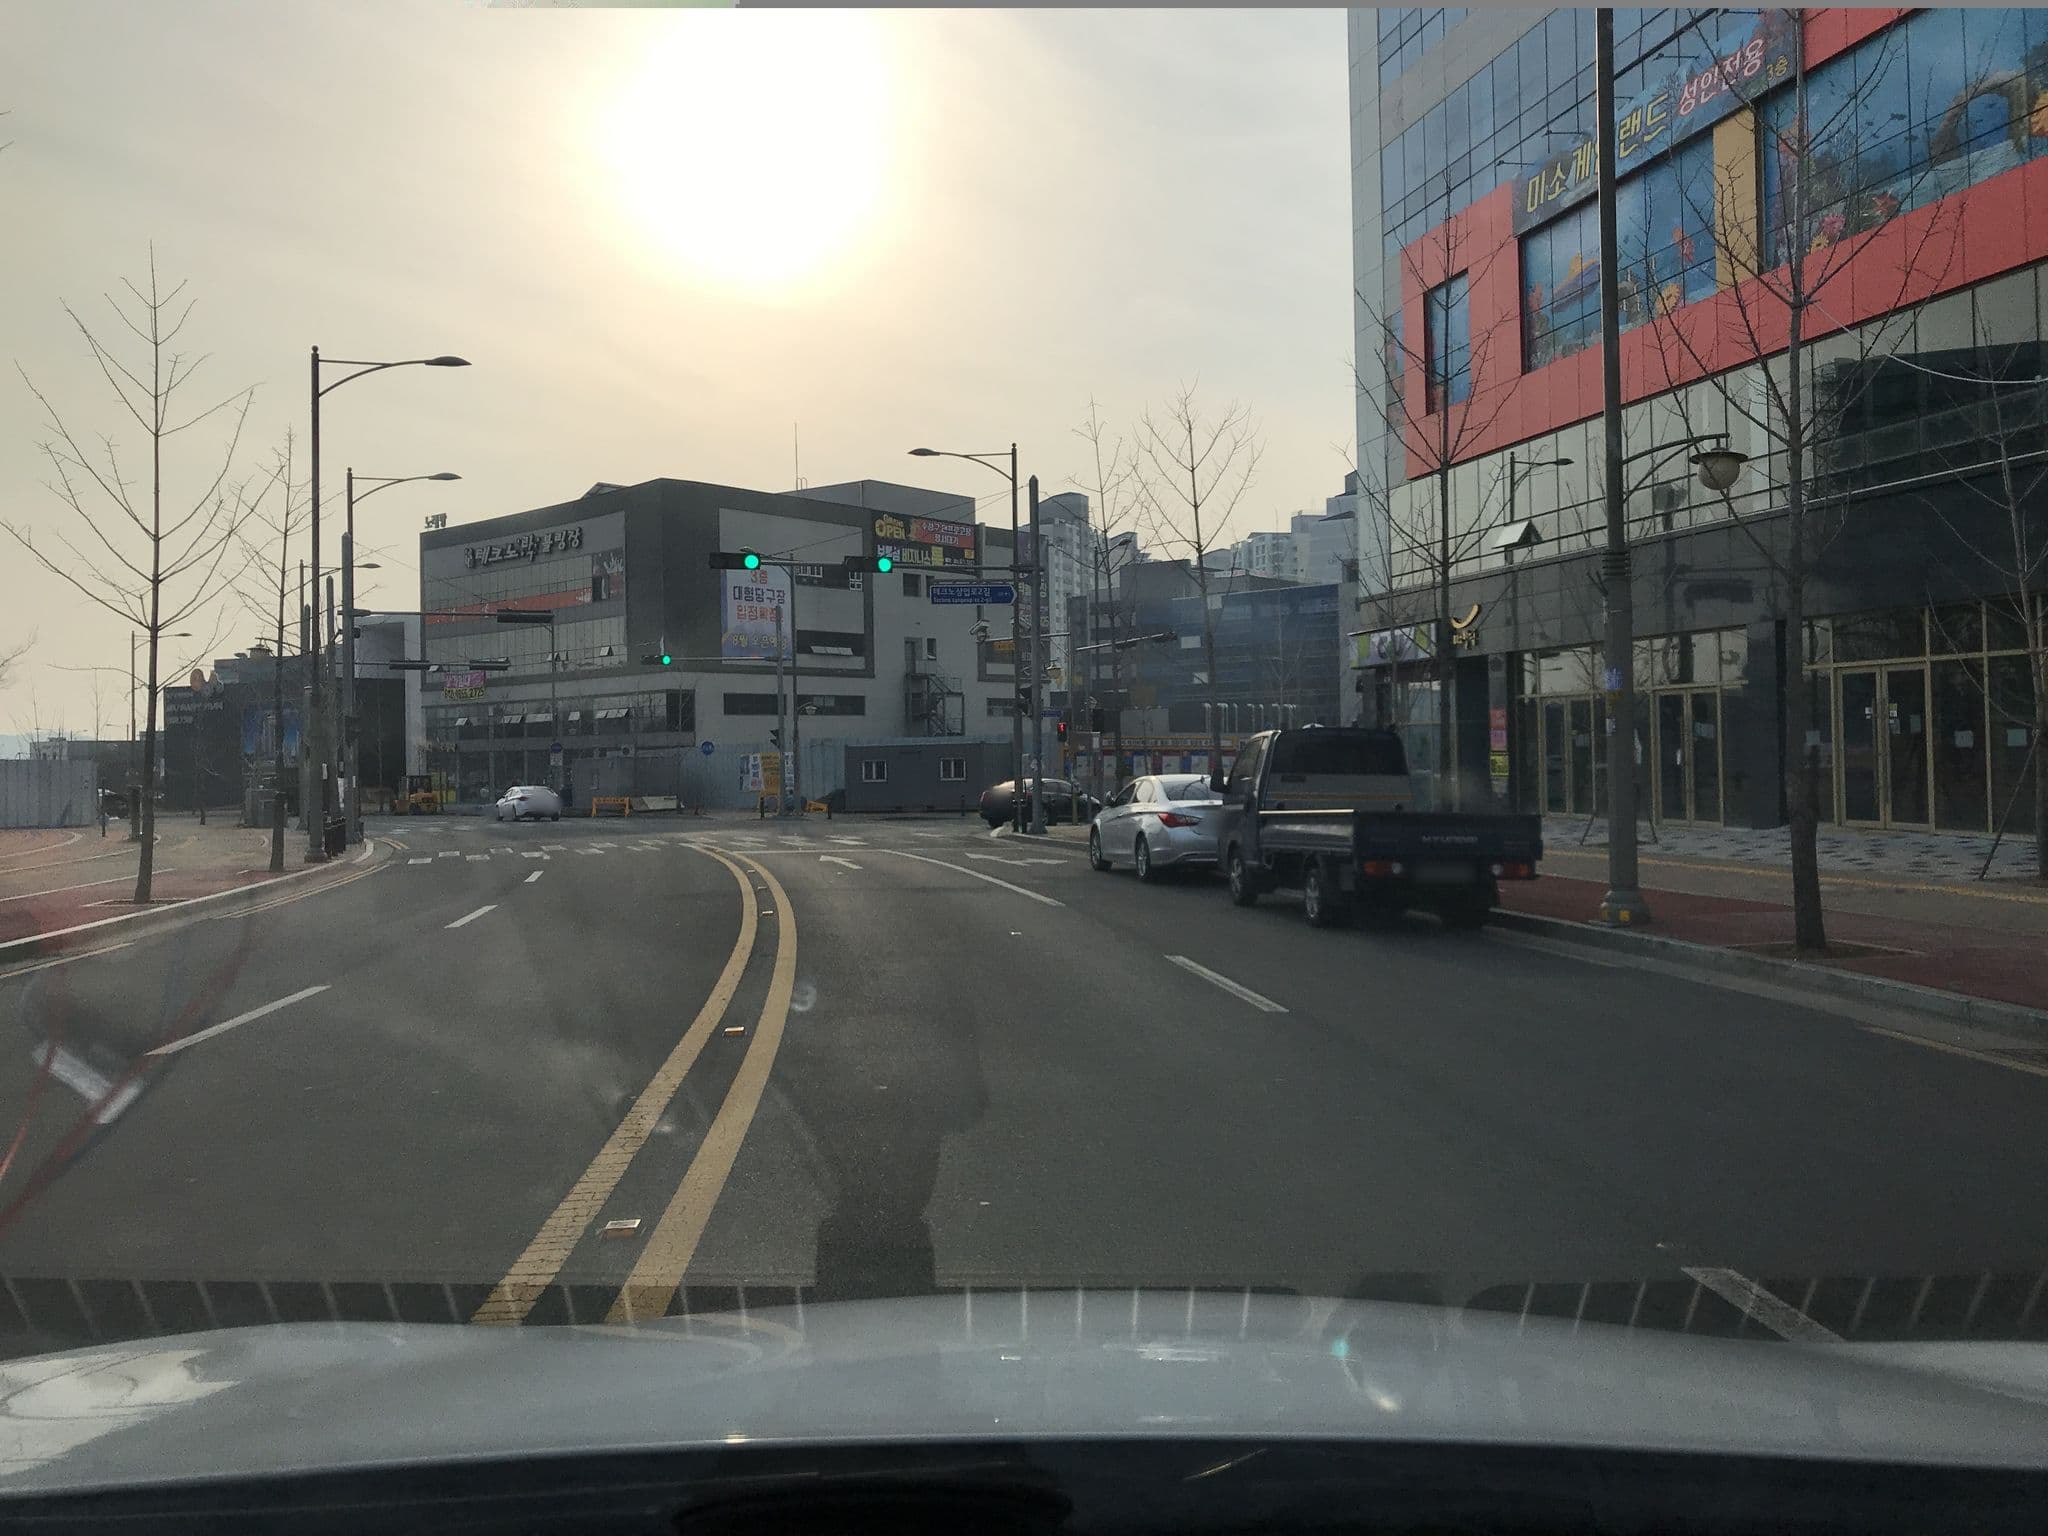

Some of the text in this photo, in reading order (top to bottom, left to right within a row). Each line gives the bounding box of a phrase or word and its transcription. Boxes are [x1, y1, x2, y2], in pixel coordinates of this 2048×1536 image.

[1678, 38, 1764, 116] 성인전용
[1766, 55, 1788, 80] 3층
[875, 519, 906, 539] OPEN
[733, 585, 786, 605] 대형당구장
